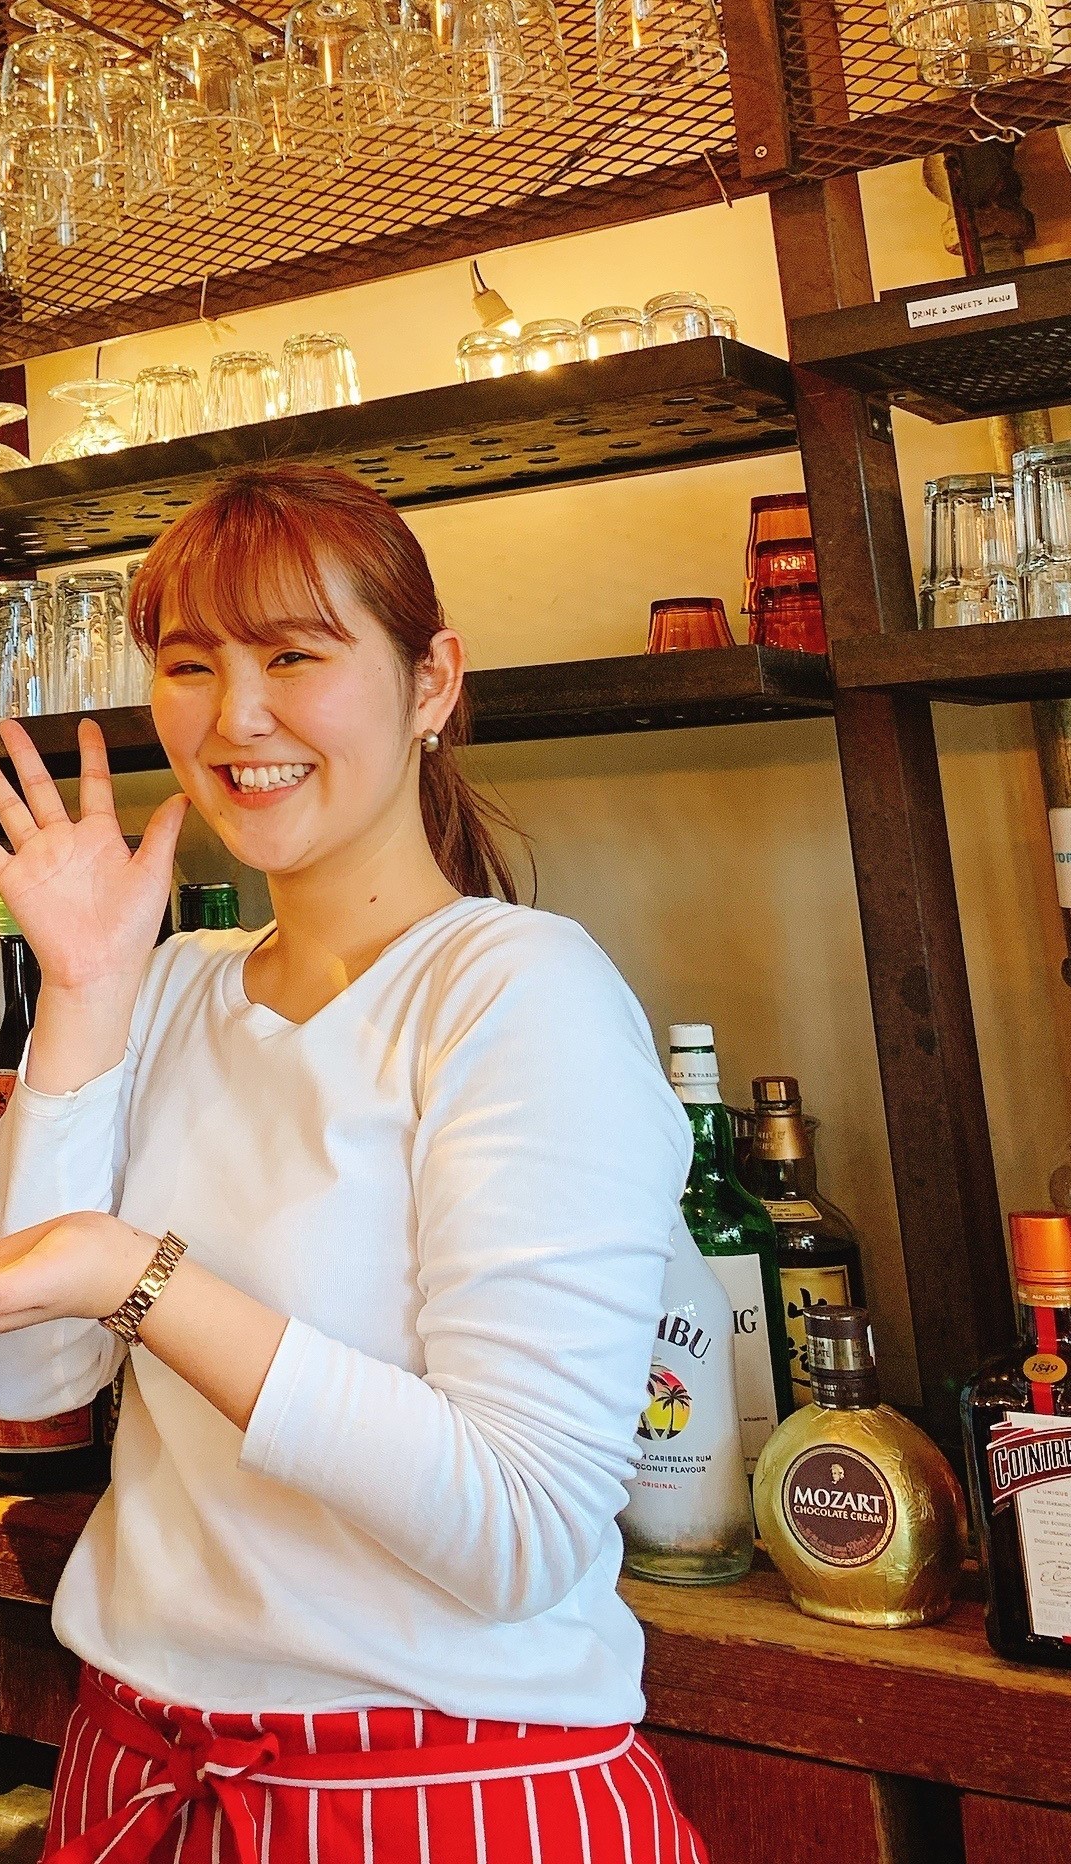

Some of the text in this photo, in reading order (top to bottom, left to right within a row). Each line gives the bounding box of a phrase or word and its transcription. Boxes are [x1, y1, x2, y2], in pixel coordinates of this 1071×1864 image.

[912, 307, 939, 320] DRINK
[950, 299, 983, 314] SWEETS
[987, 293, 1012, 306] MENU
[1031, 1362, 1059, 1374] 1849
[648, 1454, 694, 1464] CARIBBEAN
[696, 1454, 712, 1463] RUM
[670, 1465, 707, 1474] FLAVOUR
[793, 1485, 885, 1514] MOZART
[793, 1505, 884, 1524] CHOCOLATE CREAM
